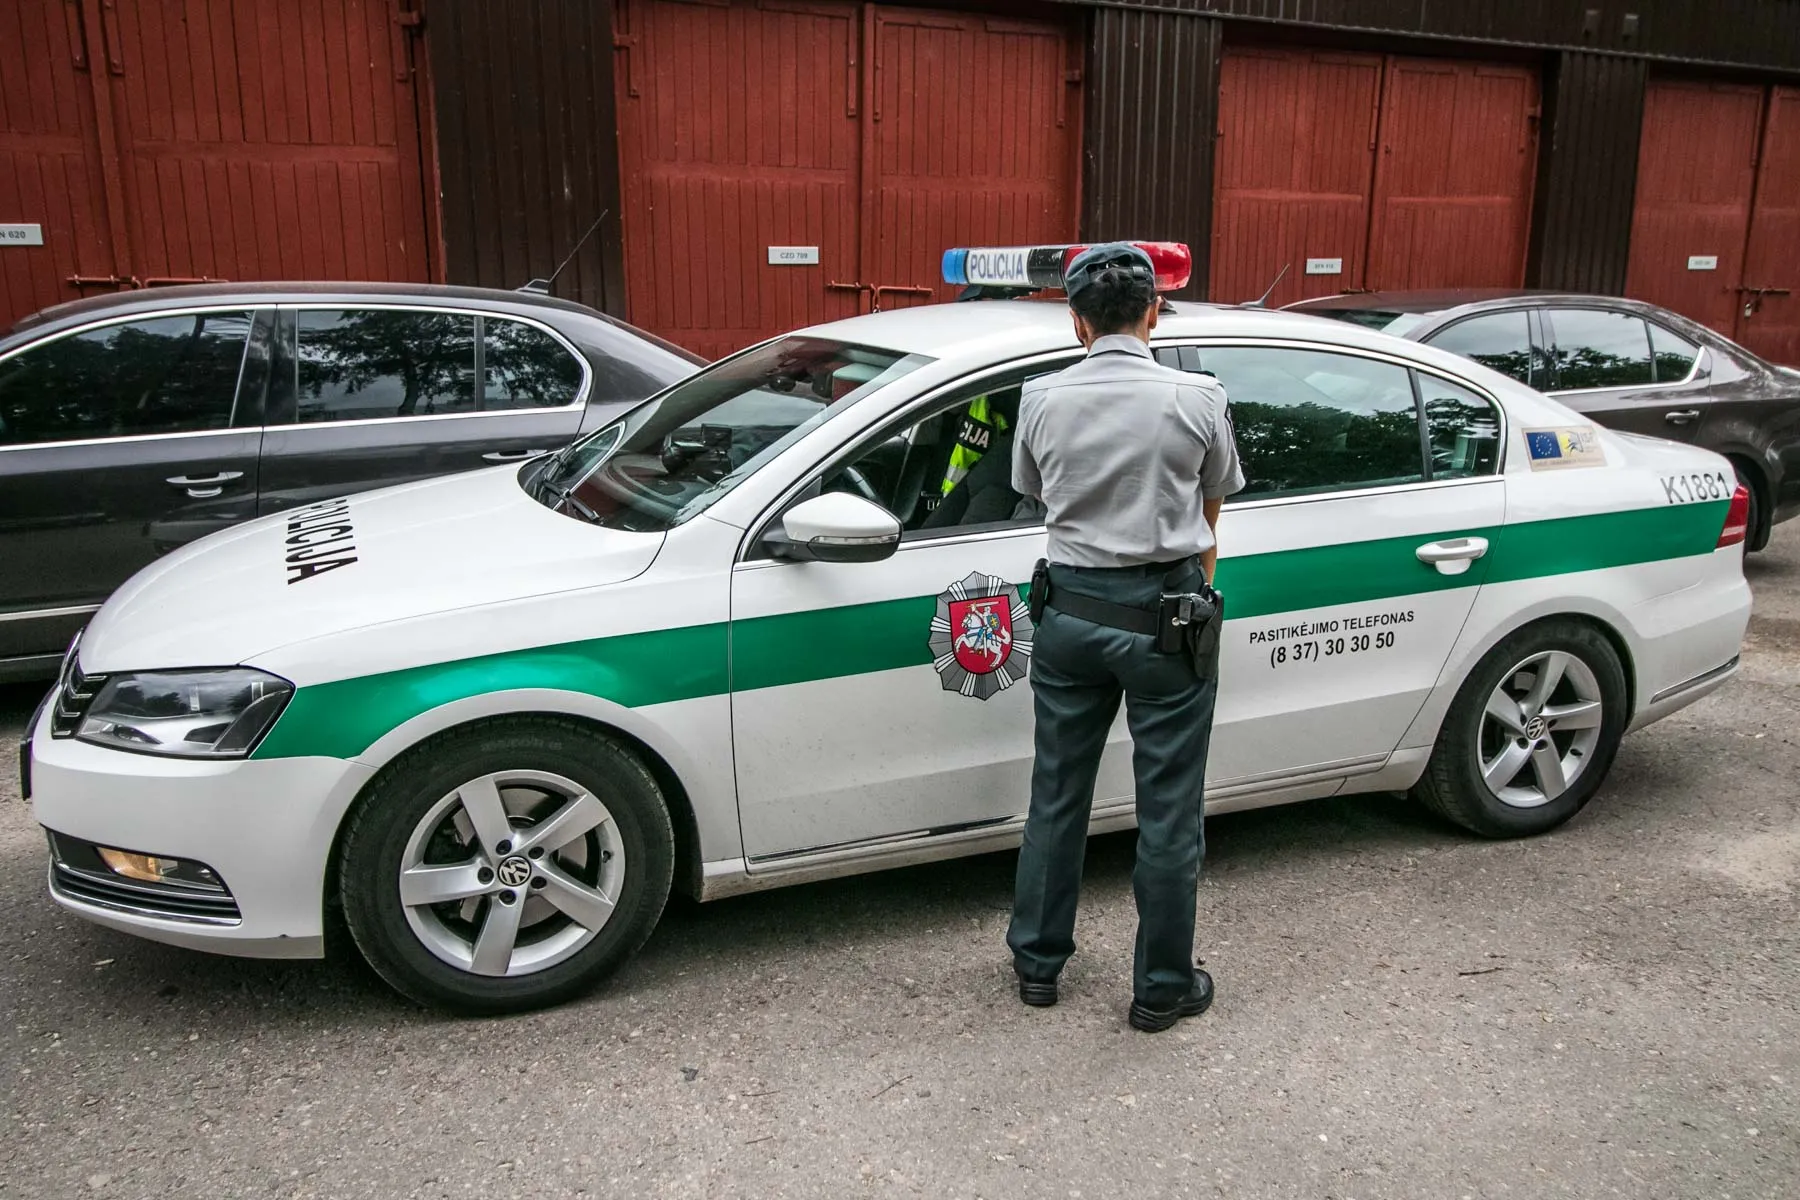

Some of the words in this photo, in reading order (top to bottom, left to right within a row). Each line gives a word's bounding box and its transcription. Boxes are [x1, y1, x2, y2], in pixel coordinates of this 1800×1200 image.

[8, 230, 26, 239] 620
[970, 253, 1024, 280] POLICIJA
[1660, 472, 1730, 504] K1881
[285, 499, 358, 585] POLICIJA
[1249, 622, 1339, 644] PASITIKĖJIMO
[1342, 610, 1415, 631] TELEFONAS
[1270, 646, 1286, 669] (8
[1292, 640, 1319, 662] 37)
[1325, 637, 1344, 656] 30
[1350, 634, 1370, 653] 30
[1375, 631, 1394, 649] 50
